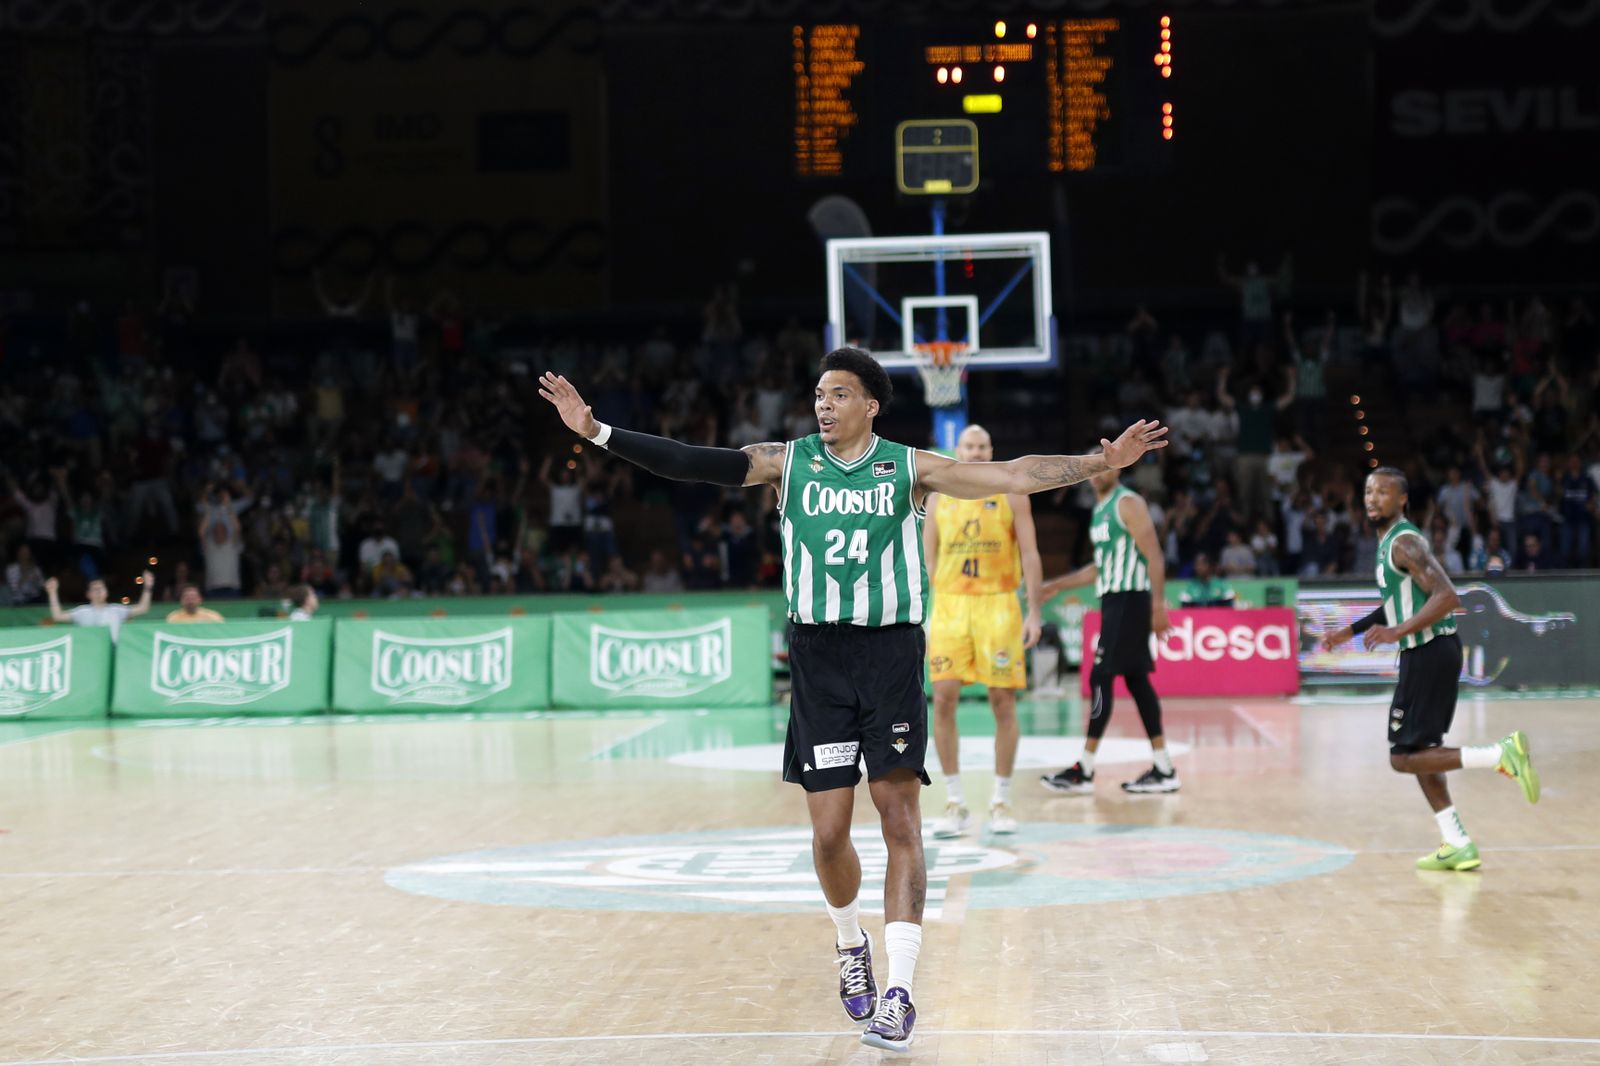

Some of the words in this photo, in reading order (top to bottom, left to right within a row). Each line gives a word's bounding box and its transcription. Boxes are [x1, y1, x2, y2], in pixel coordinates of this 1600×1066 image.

[825, 528, 869, 566] 24
[961, 557, 979, 578] 41
[0, 650, 62, 693] SUR
